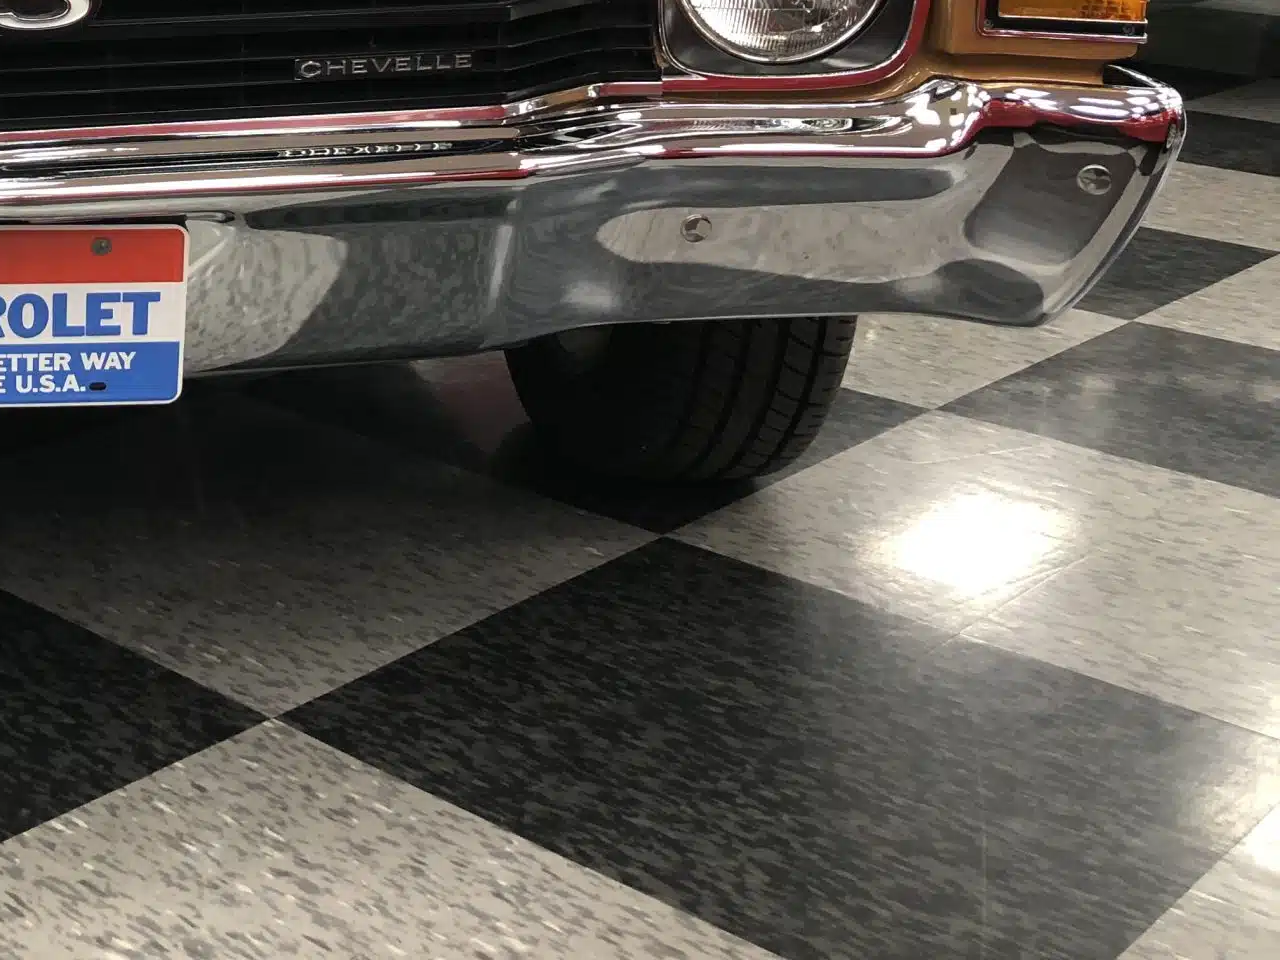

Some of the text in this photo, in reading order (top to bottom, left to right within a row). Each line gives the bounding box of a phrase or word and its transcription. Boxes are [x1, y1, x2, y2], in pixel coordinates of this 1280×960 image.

[298, 53, 473, 79] CHEVELLE
[80, 351, 136, 370] WAY
[16, 374, 86, 393] U.S.A.
